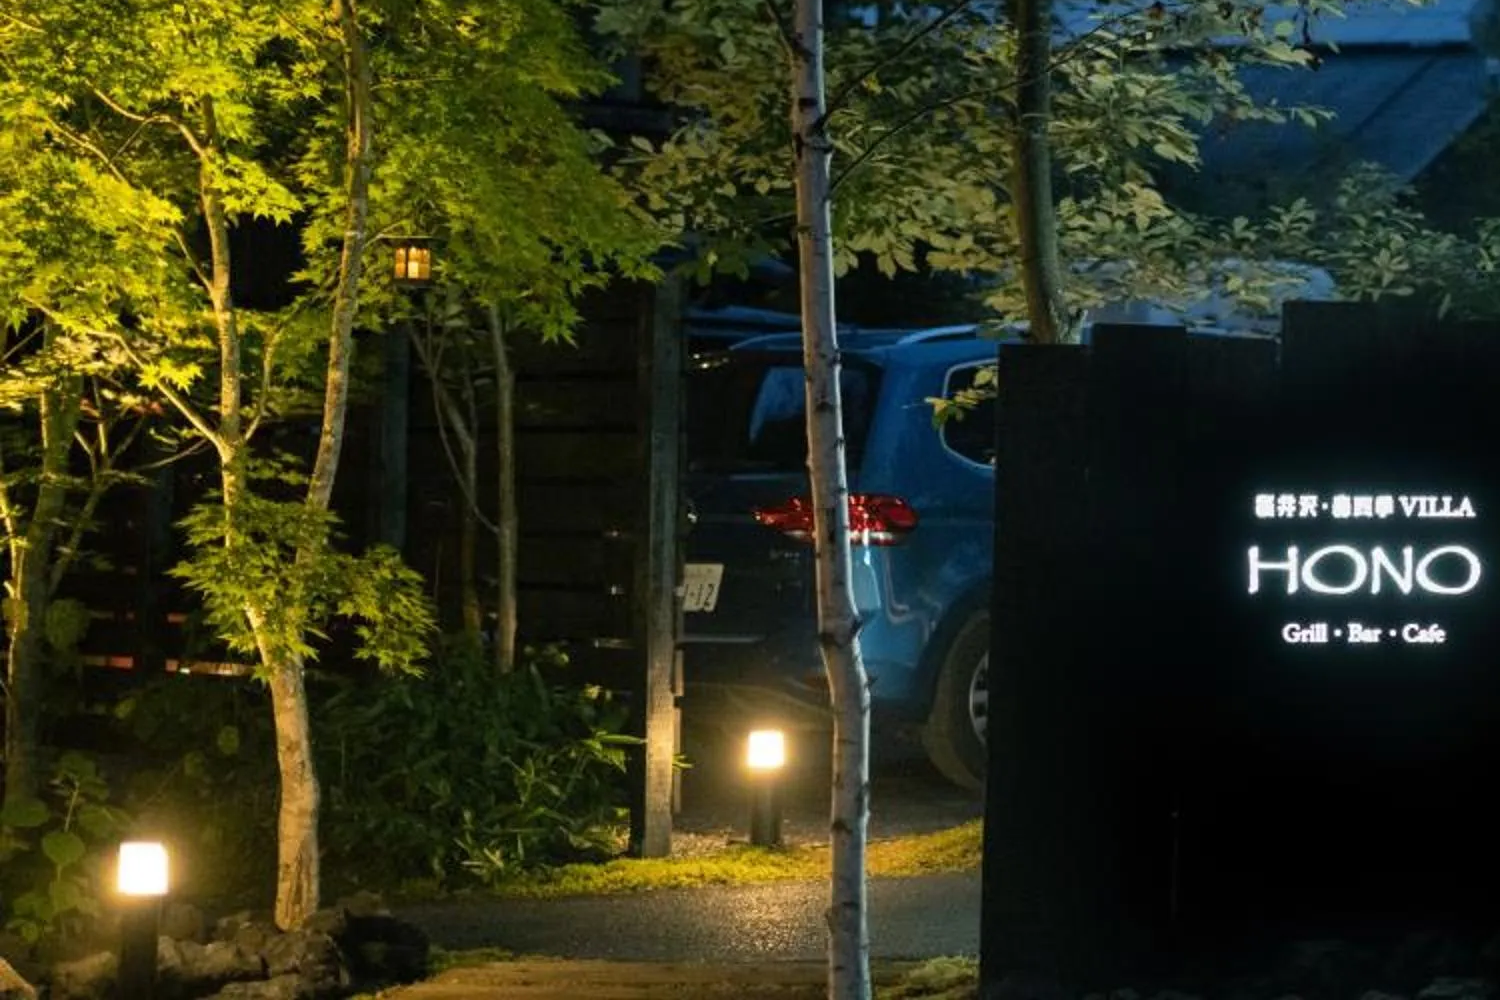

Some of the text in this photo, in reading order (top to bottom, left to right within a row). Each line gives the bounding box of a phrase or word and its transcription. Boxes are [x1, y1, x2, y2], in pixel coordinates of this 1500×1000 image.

[1397, 496, 1477, 518] VILLA
[1247, 544, 1482, 595] HONO
[1282, 622, 1446, 643] Grill Bar Cafe
